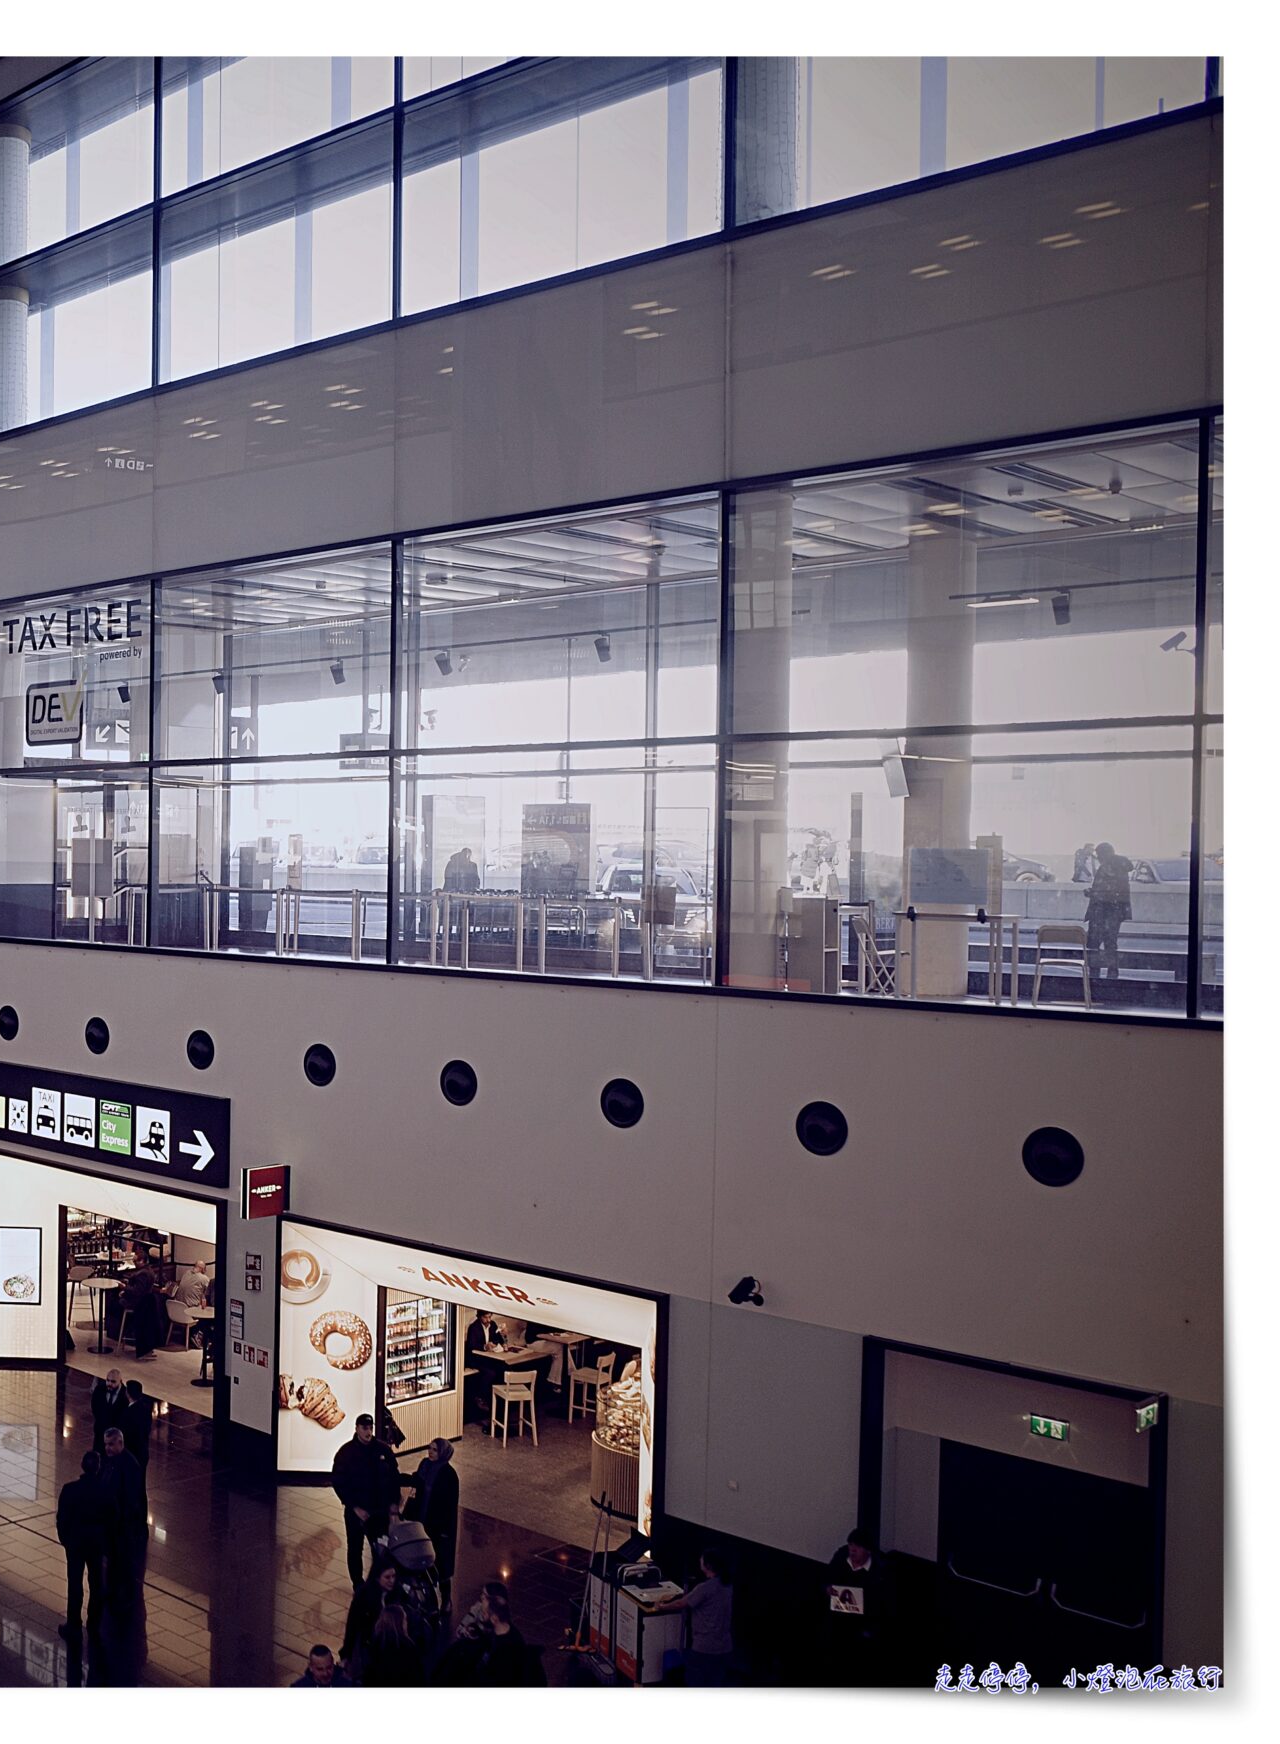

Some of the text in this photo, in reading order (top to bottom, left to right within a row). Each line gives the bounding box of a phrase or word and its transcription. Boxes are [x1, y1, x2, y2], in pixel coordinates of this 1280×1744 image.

[2, 598, 142, 655] TAX FREE
[99, 646, 142, 663] powered by
[31, 672, 87, 724] DEV
[38, 1090, 55, 1104] TAXI
[102, 1119, 117, 1132] City
[102, 1133, 129, 1149] Express
[256, 1184, 276, 1195] ANKER
[422, 1266, 536, 1307] ANKER
